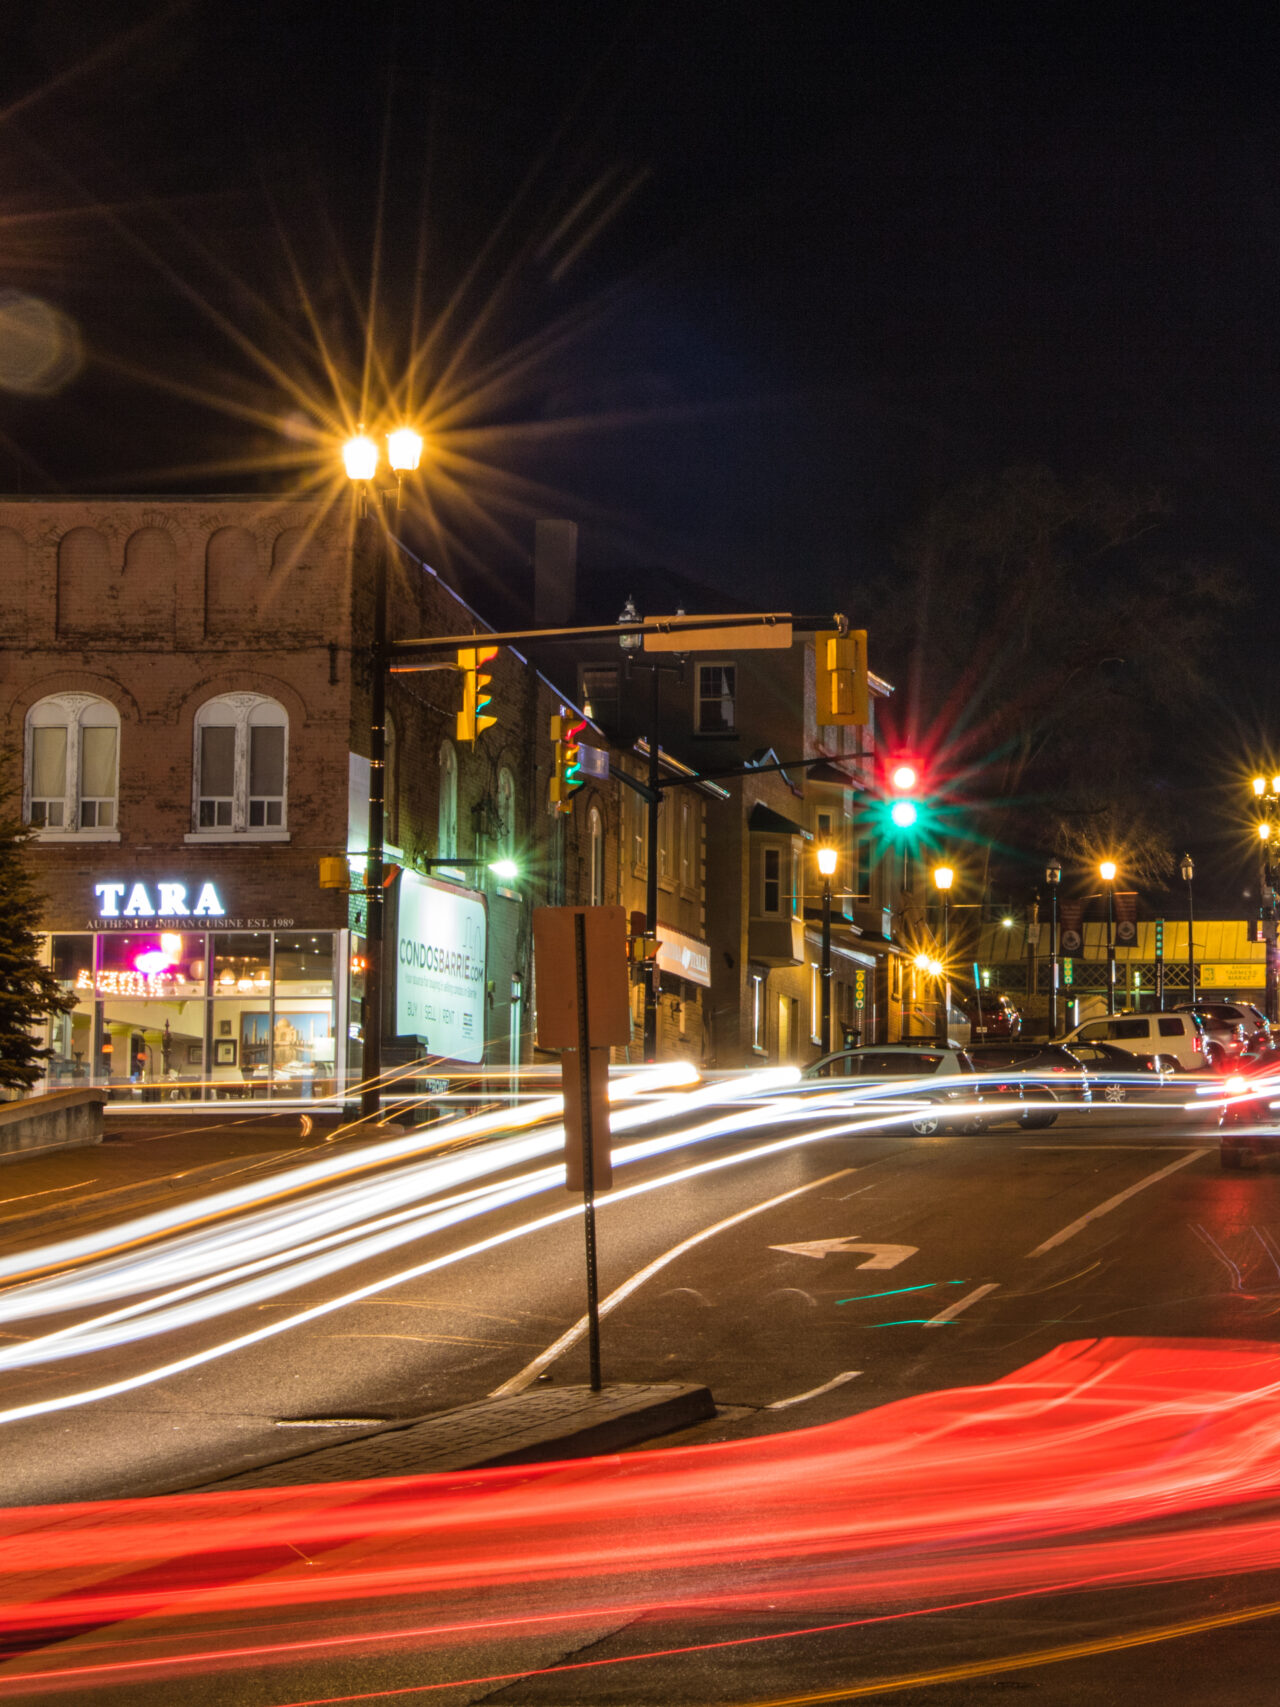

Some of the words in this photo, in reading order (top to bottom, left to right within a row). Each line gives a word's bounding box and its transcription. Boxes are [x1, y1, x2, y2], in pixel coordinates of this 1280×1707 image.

[95, 882, 226, 917] TARA
[86, 919, 151, 930] AUTHENTIC
[155, 919, 195, 929] INDIAN
[199, 919, 243, 929] CUISINE
[247, 918, 270, 929] EST.
[273, 918, 295, 928] 1989
[399, 938, 485, 983] CONDOSBARRIE.COM
[407, 1001, 418, 1017] BUY
[424, 1004, 437, 1022] SELL
[442, 1008, 456, 1025] RENT
